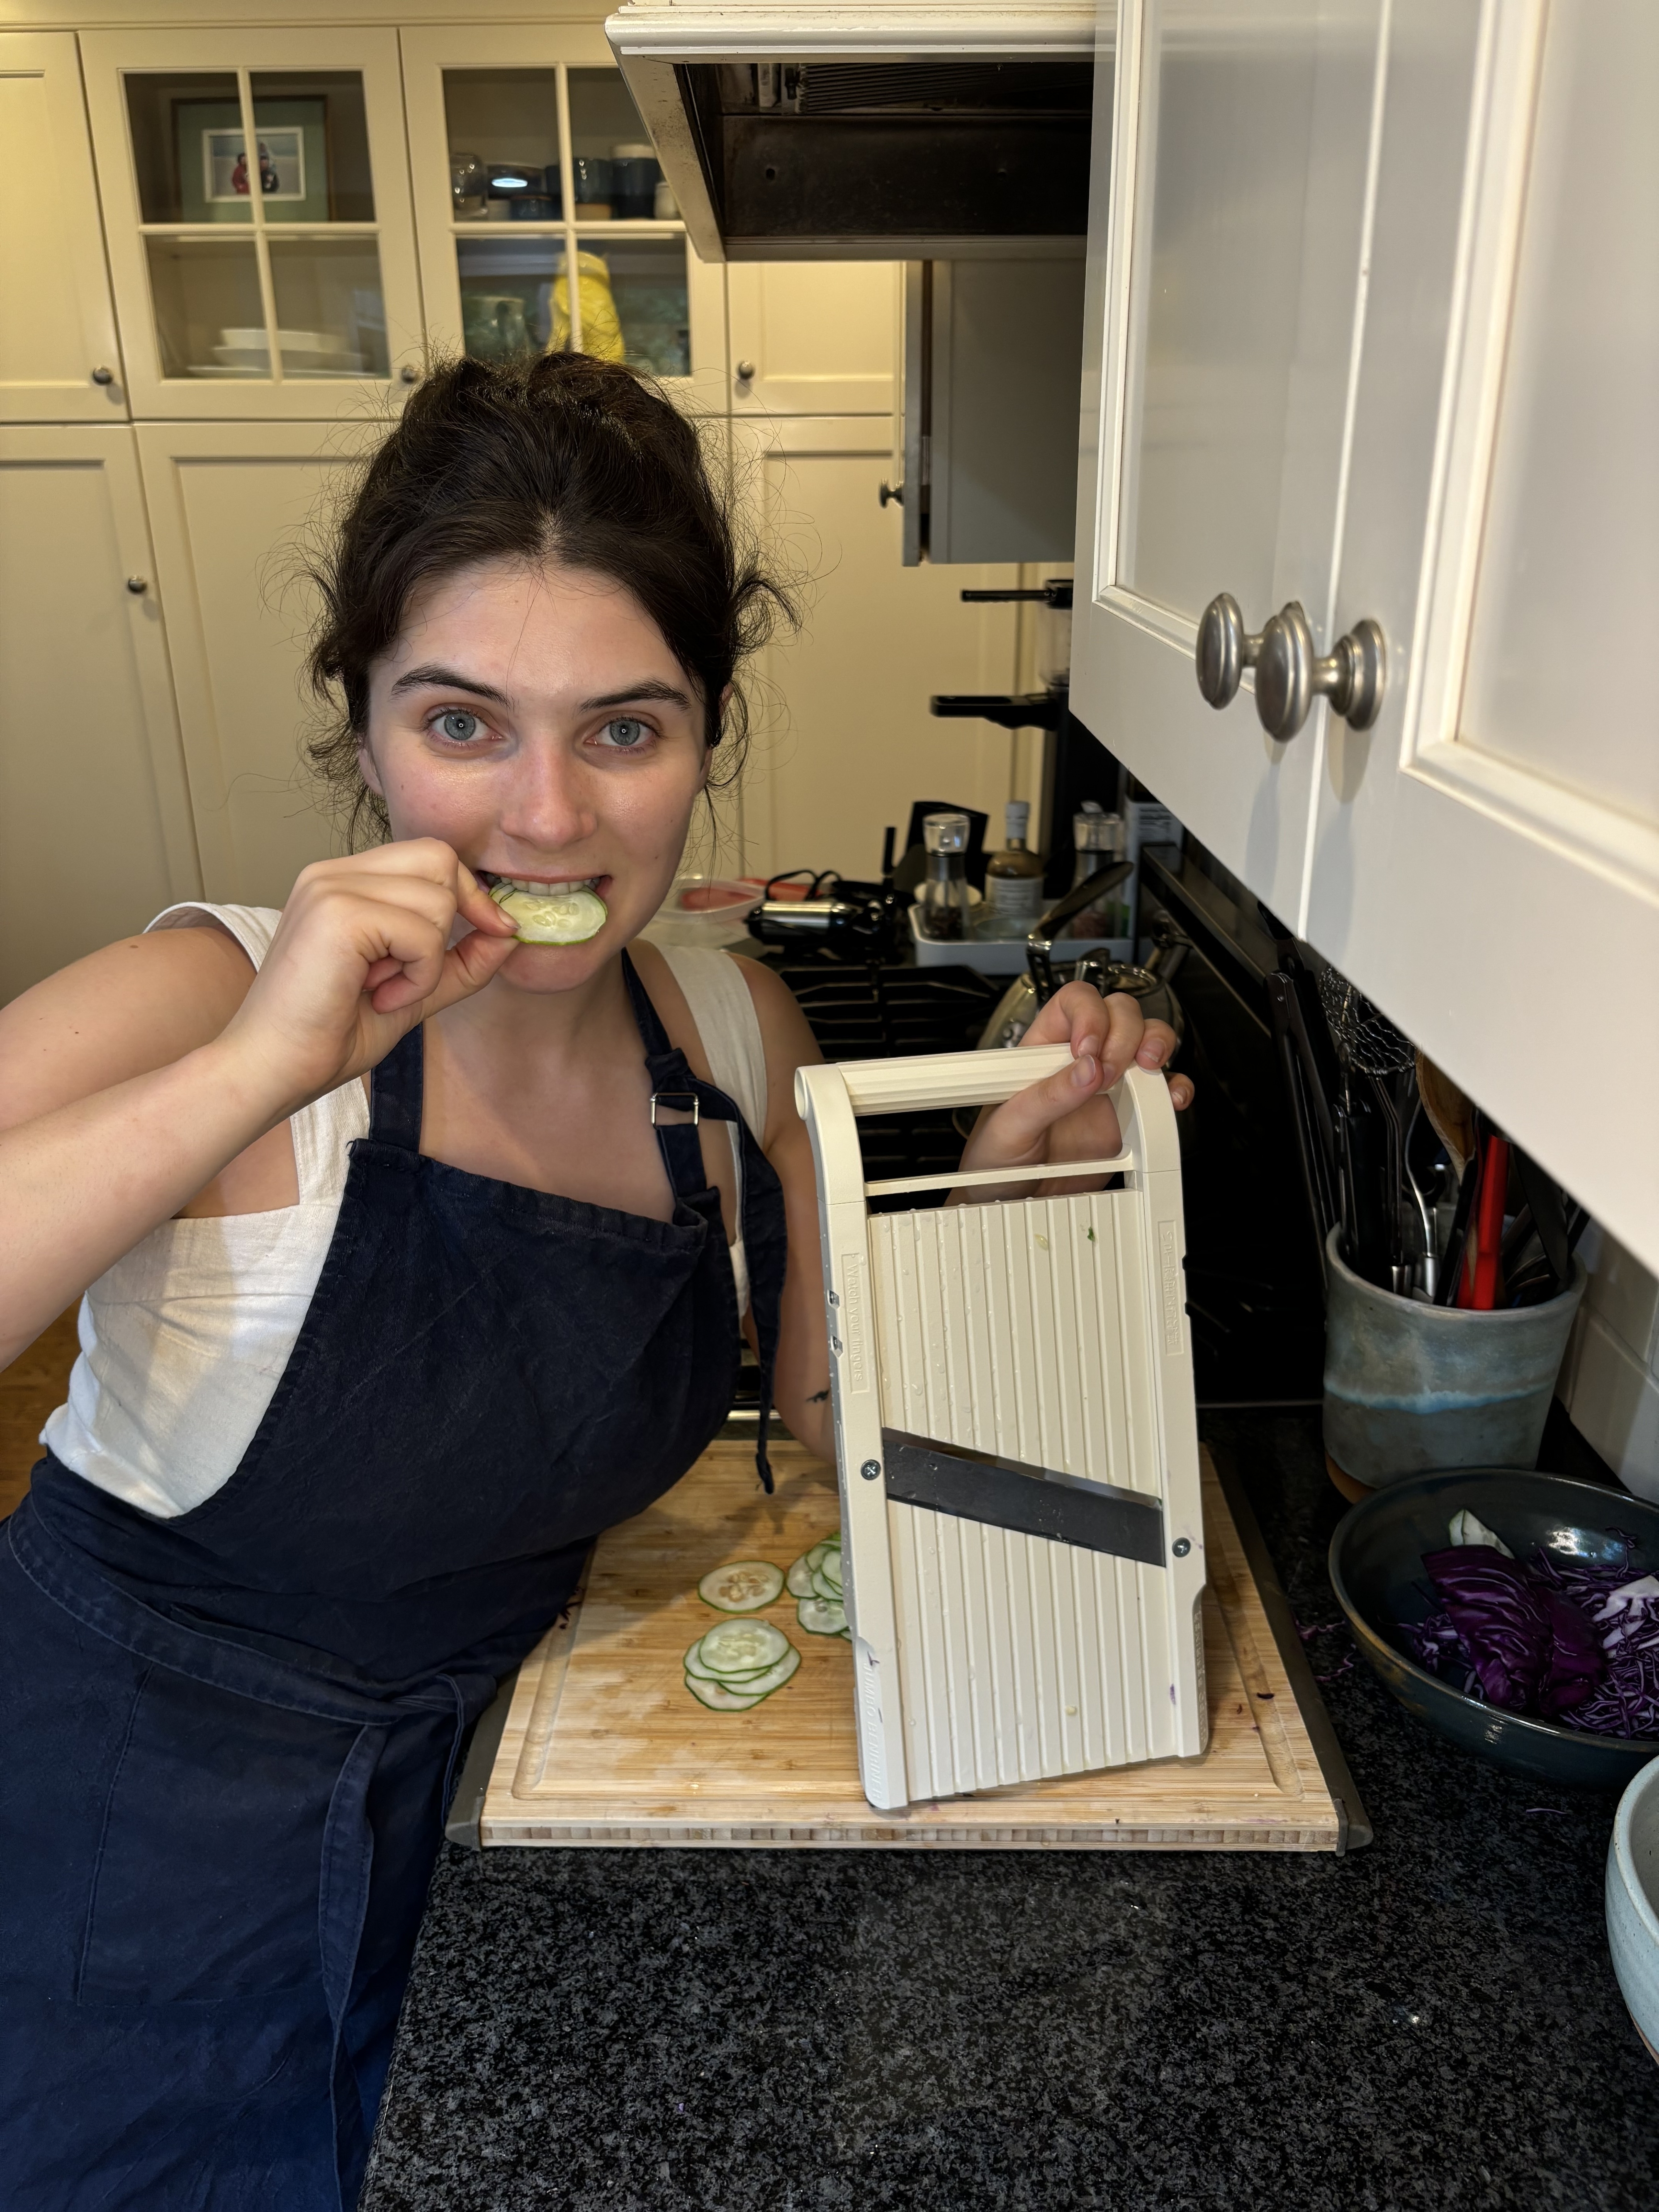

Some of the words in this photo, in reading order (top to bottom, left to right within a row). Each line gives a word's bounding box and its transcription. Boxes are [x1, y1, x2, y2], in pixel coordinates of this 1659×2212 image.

[847, 1264, 860, 1304] Watch
[848, 1308, 861, 1334] your
[850, 1338, 864, 1381] fingers
[863, 1663, 876, 1716] JUMBO
[867, 1721, 883, 1799] BENRINER
